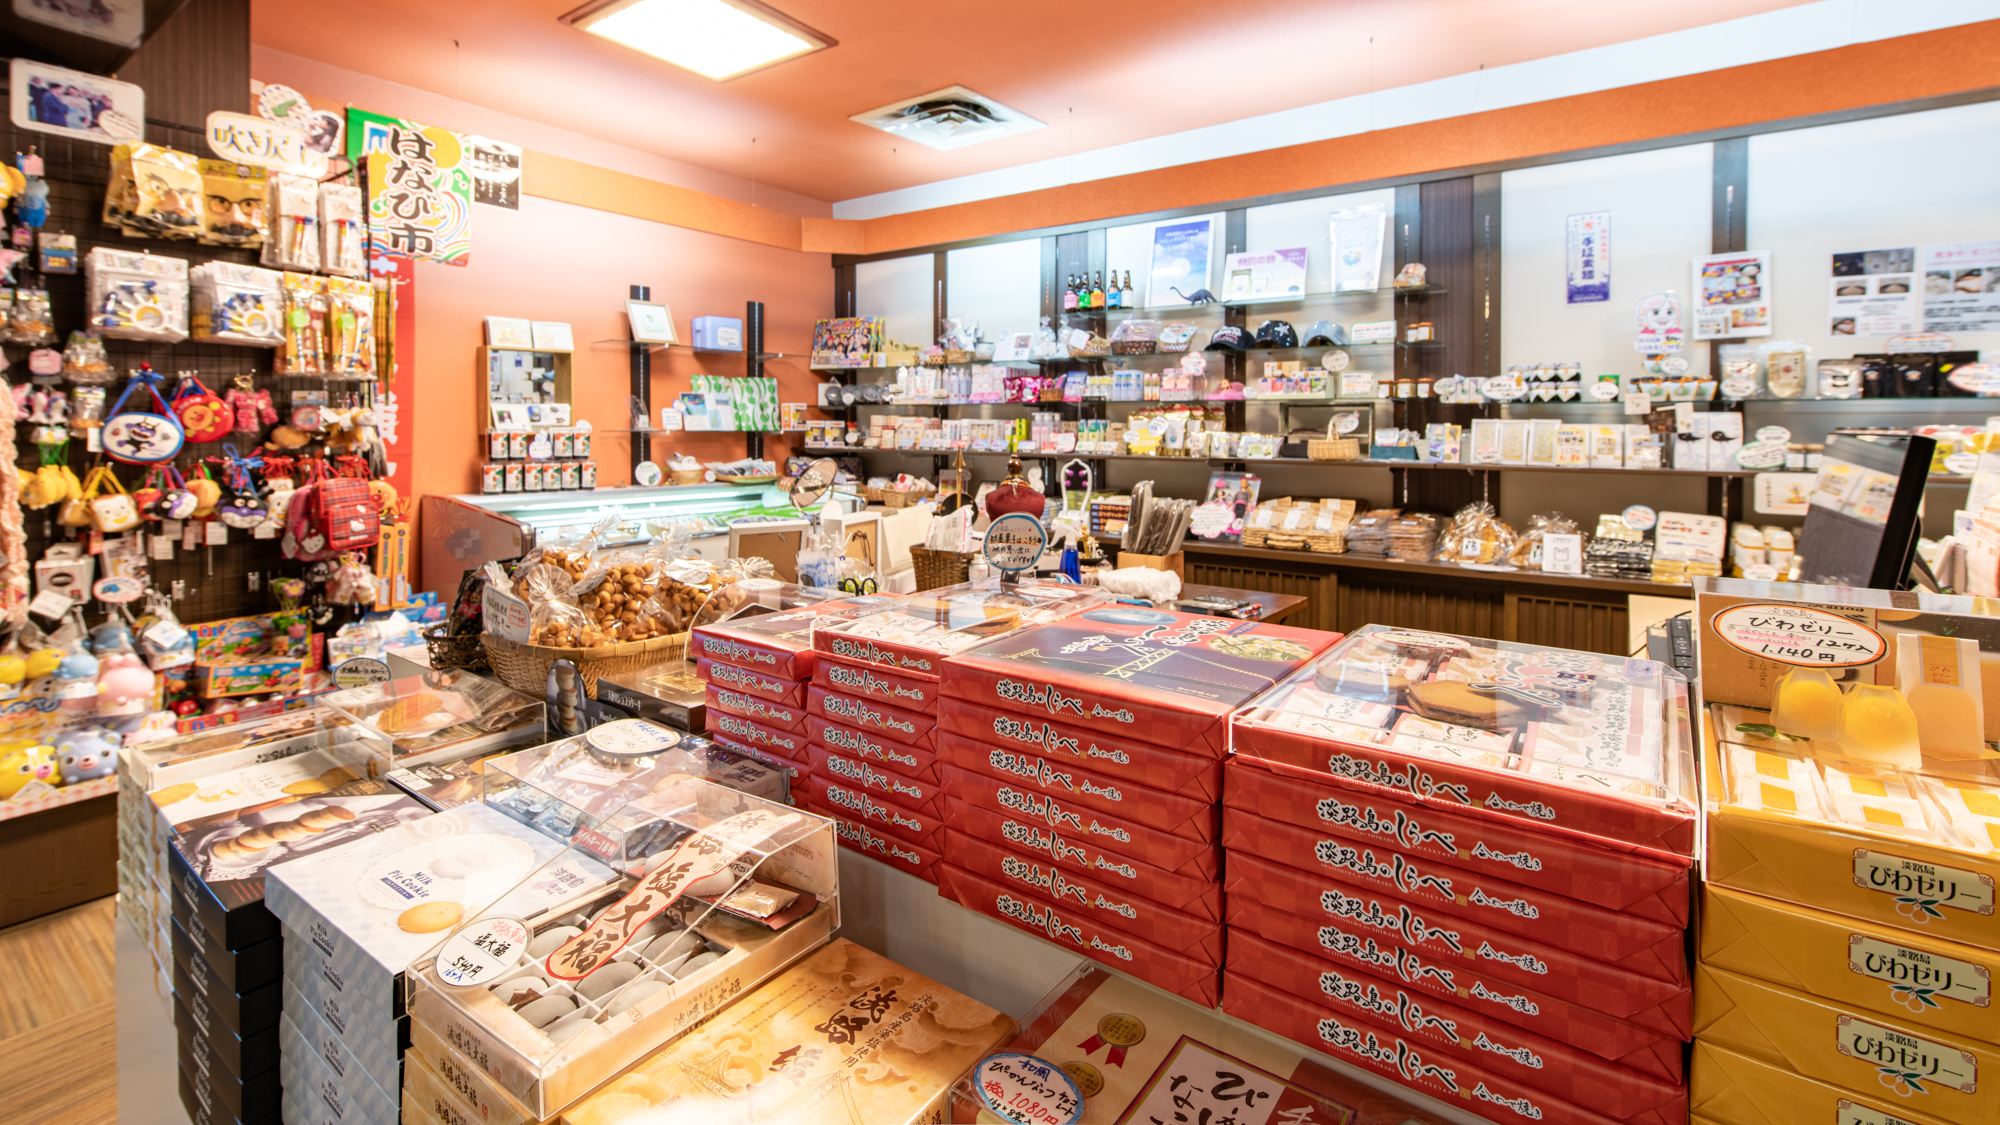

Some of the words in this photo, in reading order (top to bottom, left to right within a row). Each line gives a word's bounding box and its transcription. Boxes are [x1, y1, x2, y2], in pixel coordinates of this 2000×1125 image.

[388, 127, 436, 254] はなび市
[1749, 616, 1854, 636] びわゼリー
[833, 639, 895, 665] 淡路島のしらべ
[830, 666, 889, 694] 淡路島のしらべ
[824, 695, 881, 725] 淡路島のしらべ
[997, 679, 1084, 714] 淡路島のしらべ
[1092, 703, 1134, 723] 合わせ焼き
[824, 726, 883, 759] 淡路島のしらべ
[994, 717, 1079, 753] 淡路島のしらべ
[1088, 743, 1130, 764] 合わせ焼き
[828, 755, 887, 788] 淡路島のしらべ
[990, 750, 1073, 788] 淡路島のしらべ
[1082, 779, 1122, 801] 合わせ焼き
[1330, 754, 1471, 803] 淡路島のしらべ
[1486, 792, 1556, 819] 合わせ焼き
[827, 786, 886, 819] 淡路島のしらべ
[997, 787, 1081, 827] 淡路島のしらべ
[1090, 820, 1131, 843] 合わせ焼き
[835, 818, 886, 852] 路島のしらべ
[1317, 798, 1458, 853] 淡路島のしらべ
[1472, 841, 1542, 870] 合わせ焼き
[1322, 821, 1359, 835] AWAJISHIMA
[1367, 833, 1395, 844] SHIRABE
[1002, 820, 1087, 861] 淡路島のしらべ
[1095, 855, 1136, 879] 合わせ焼き
[1411, 844, 1455, 859] AWASEYAKI
[411, 871, 433, 887] Milk
[1316, 840, 1455, 899] 淡路島のしらべ
[1469, 887, 1539, 918] 合わせ焼き
[1320, 863, 1357, 878] AWAJISHIMA
[1365, 875, 1393, 887] SHIRABE
[1869, 864, 1982, 901] びわゼリー
[1901, 860, 1935, 876] 淡路島
[388, 869, 403, 881] Pie
[401, 877, 431, 899] Cookie
[1002, 856, 1087, 899] 淡路島のしらべ
[1095, 894, 1136, 919] 合わせ焼き
[1409, 889, 1453, 904] AWASEYAKI
[997, 894, 1083, 939] 淡路島のしらべ
[1091, 935, 1133, 961] 合わせ焼き
[1321, 890, 1462, 952] 淡路島のしらべ
[1477, 942, 1547, 974] 合わせ焼き
[1326, 913, 1363, 929] AWAJISHIMA
[1371, 927, 1400, 939] SHIRABE
[319, 933, 335, 952] Cookie
[1416, 941, 1460, 958] AWASEYAKI
[1897, 948, 1930, 965] 淡路島
[452, 956, 483, 978] 540円
[1318, 926, 1457, 991] 淡路島のしらべ
[1470, 982, 1539, 1015] 合わせ焼き
[1323, 948, 1360, 965] AWAJISHIMA
[1367, 963, 1395, 976] SHIRABE
[1865, 951, 1977, 991] びわゼリー
[329, 967, 344, 987] Cookie
[1411, 979, 1454, 996] AWASEYAKI
[331, 1009, 346, 1030] Cookie
[1319, 972, 1460, 1042] 淡路島のしらべ
[1473, 1032, 1543, 1069] 合わせ焼き
[1325, 995, 1362, 1012] AWAJISHIMA
[1369, 1011, 1398, 1025] SHIRABE
[1413, 1028, 1457, 1047] AWASEYAKI
[1884, 1031, 1918, 1050] 淡路島
[330, 1051, 345, 1073] Cookie
[1317, 1019, 1458, 1092] 淡路島のしらべ
[1473, 1082, 1542, 1119] 合わせ焼き
[1323, 1041, 1360, 1060] AWAJISHIMA
[1368, 1059, 1396, 1073] SHIRABE
[1852, 1033, 1964, 1076] びわゼリー
[1018, 1059, 1051, 1083] 和風
[984, 1080, 1005, 1099] 税込
[1059, 1091, 1079, 1107] チョコ
[1412, 1077, 1456, 1097] AWASEYAKI
[328, 1092, 344, 1115] Cookie
[1008, 1092, 1059, 1125] 1080円
[1055, 1103, 1074, 1117] レート
